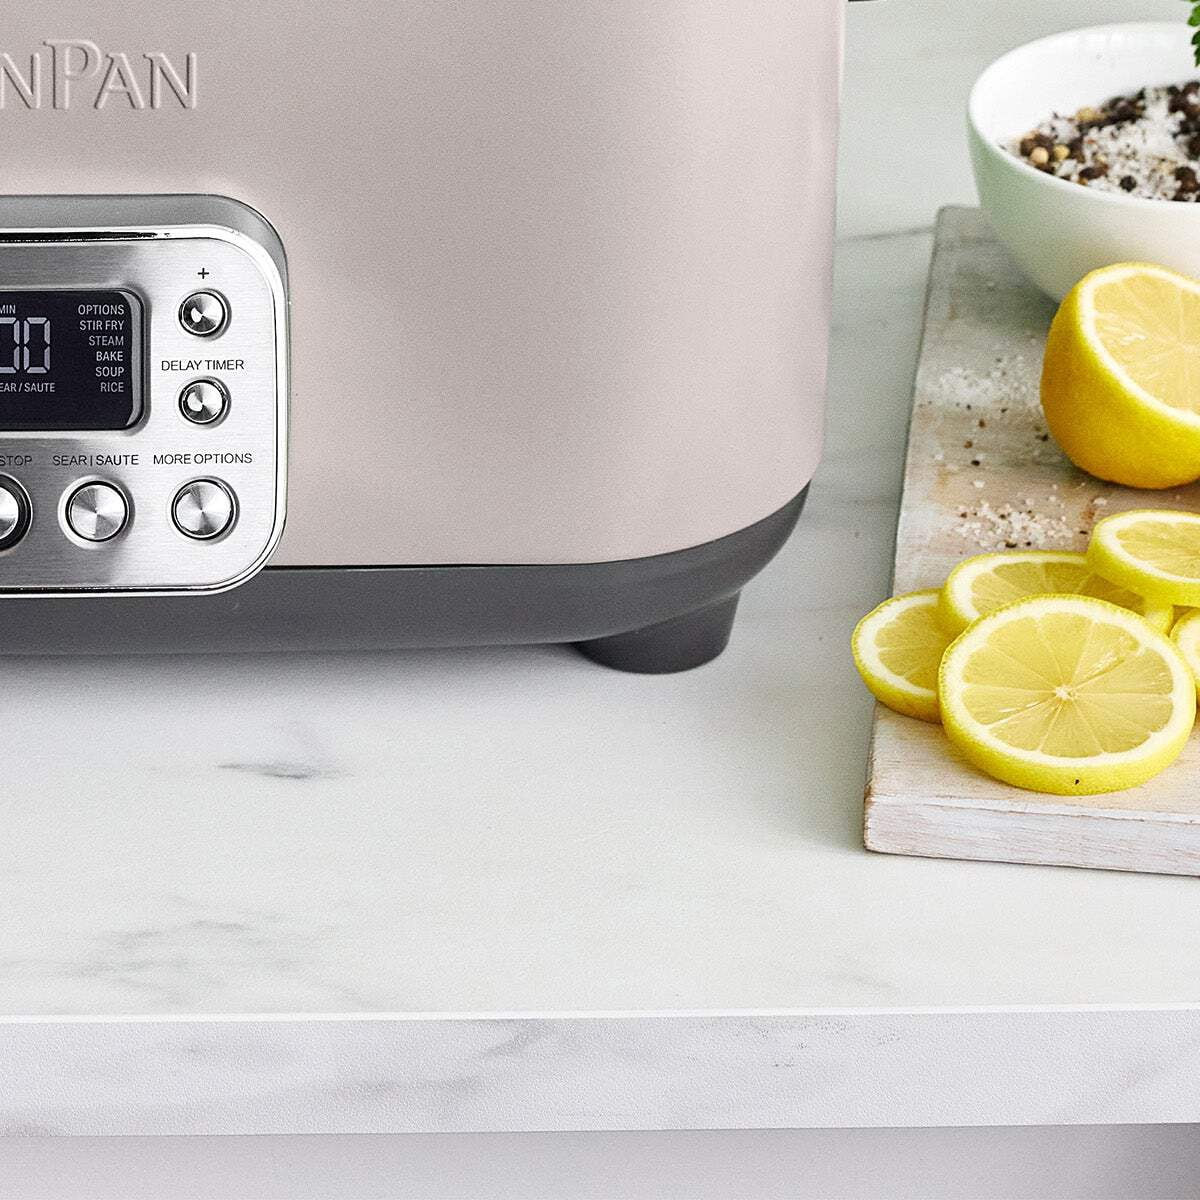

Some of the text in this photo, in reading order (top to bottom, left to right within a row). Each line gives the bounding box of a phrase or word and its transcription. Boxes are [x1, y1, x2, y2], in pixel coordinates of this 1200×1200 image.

[78, 304, 125, 315] OPTIONS
[79, 320, 125, 330] STIR FRY
[88, 335, 124, 345] STEAM
[96, 351, 124, 361] BAKE
[161, 359, 244, 372] DELAY TIMER
[95, 366, 125, 376] SOUP
[24, 382, 56, 392] SAUTE
[100, 382, 124, 392] RICE
[52, 453, 88, 466] SEAR
[97, 453, 139, 466] SAUTE
[153, 452, 253, 466] MORE OPTIONS
